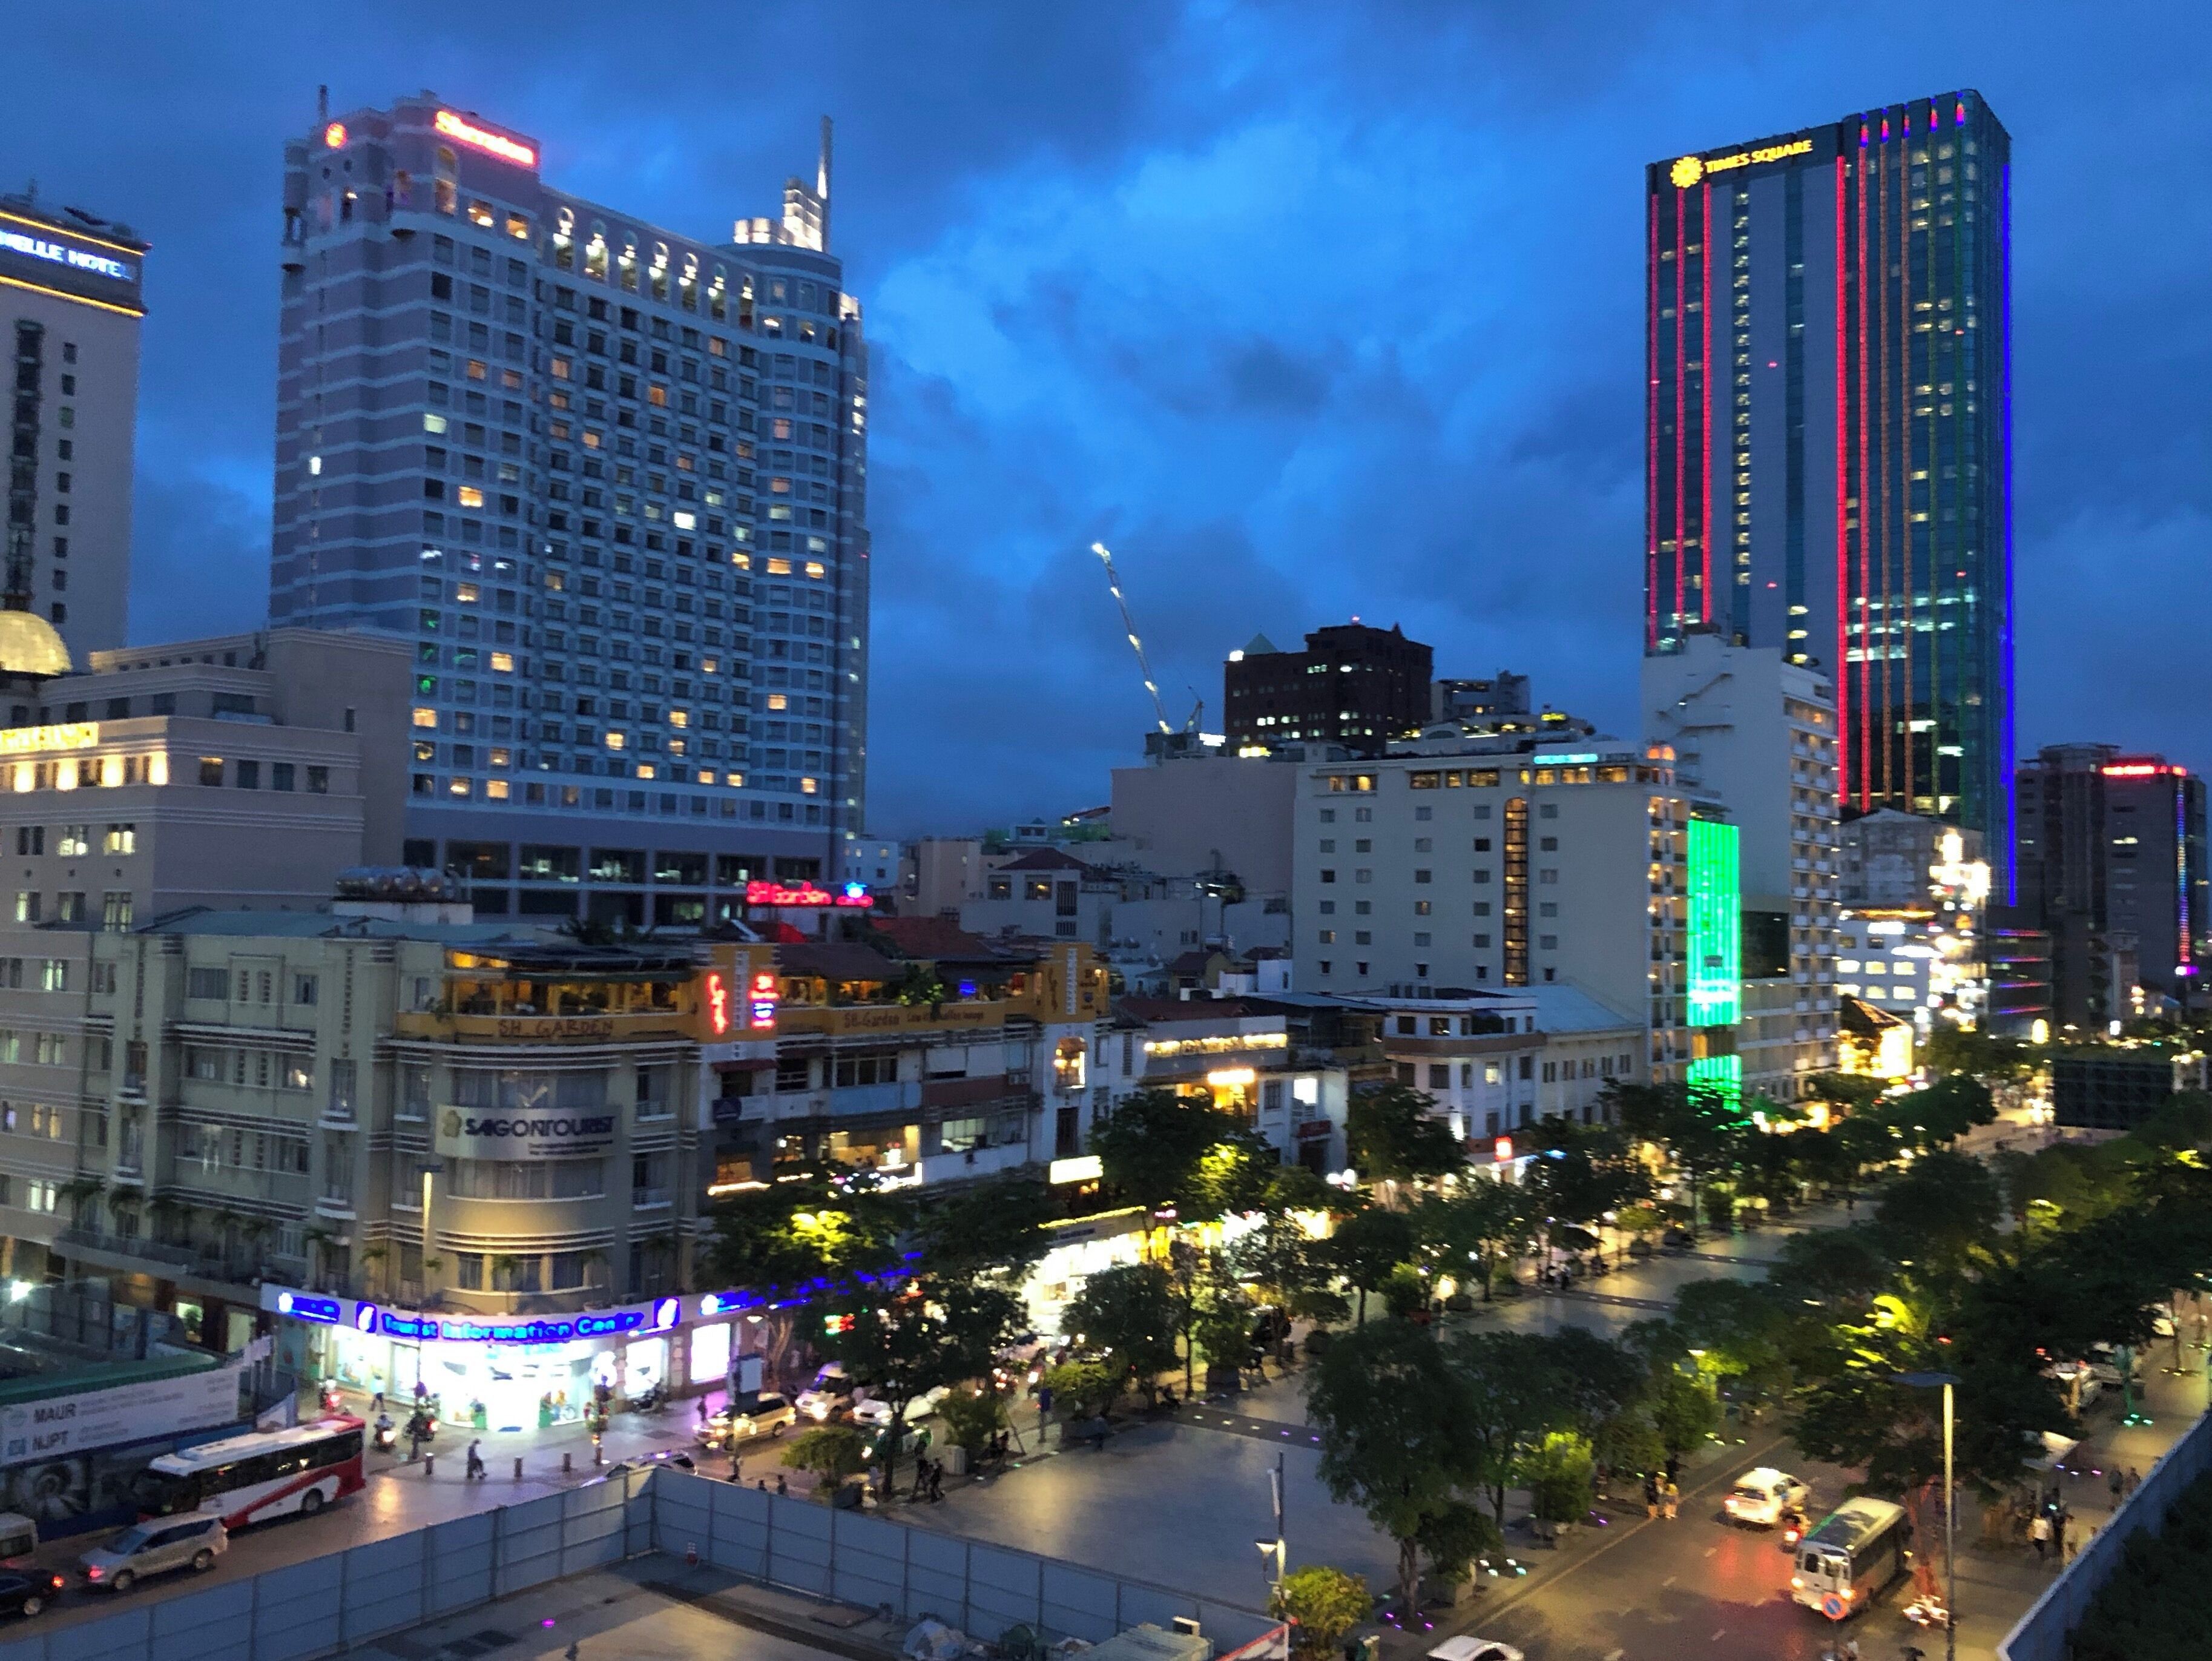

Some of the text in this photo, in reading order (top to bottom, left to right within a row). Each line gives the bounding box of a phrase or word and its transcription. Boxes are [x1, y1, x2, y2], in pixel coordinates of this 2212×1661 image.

[1704, 139, 1814, 174] TIMES SQUARE
[771, 882, 832, 905] Garden
[498, 1019, 613, 1037] SH GARDEN
[442, 1321, 571, 1339] Information
[576, 1313, 643, 1334] Cene
[34, 1403, 77, 1424] MAUR
